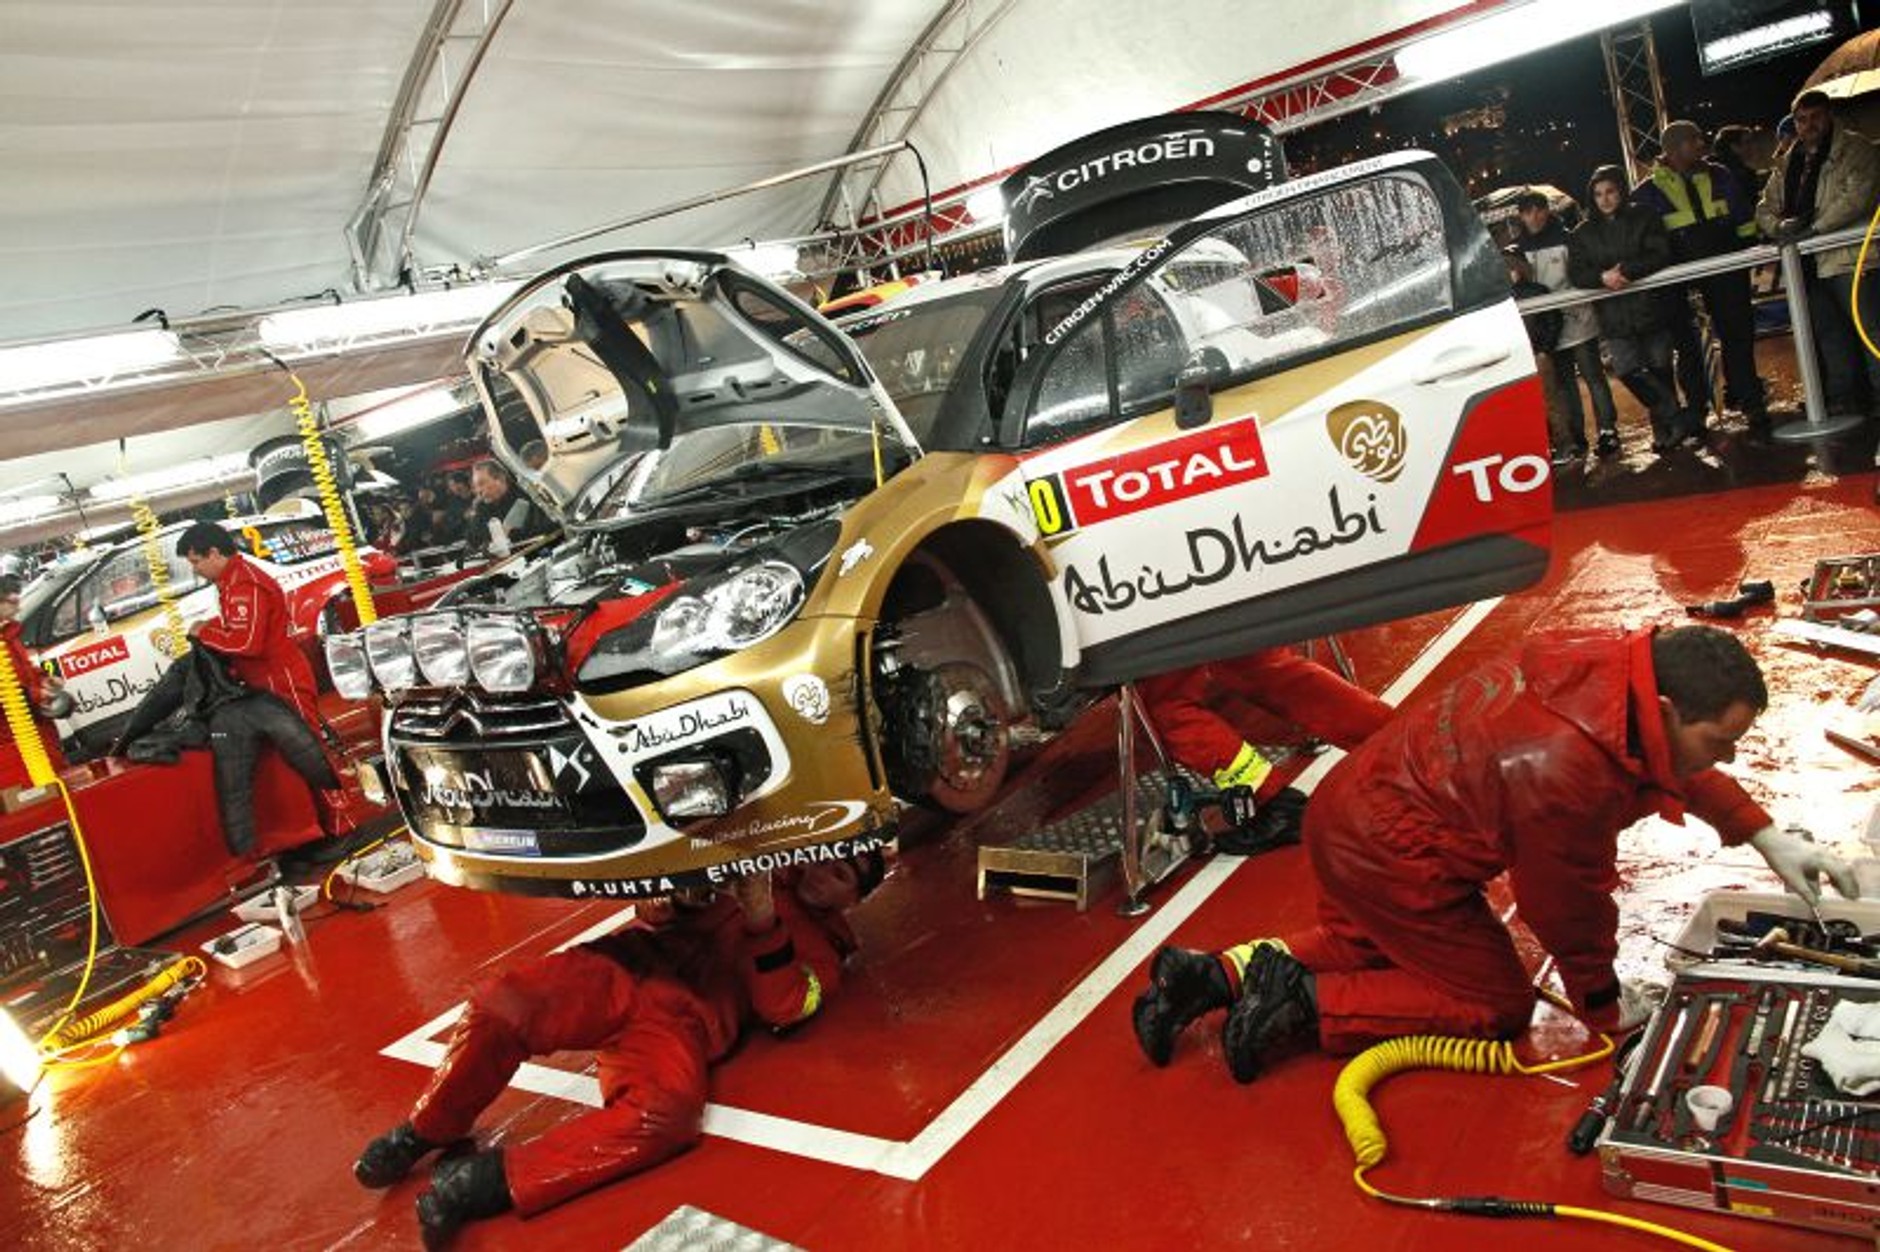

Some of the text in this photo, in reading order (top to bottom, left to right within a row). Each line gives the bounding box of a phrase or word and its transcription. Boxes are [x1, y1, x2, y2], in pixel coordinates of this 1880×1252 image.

[1074, 445, 1257, 509] TOTAL
[242, 525, 272, 559] 2
[63, 645, 126, 672] TOTAL
